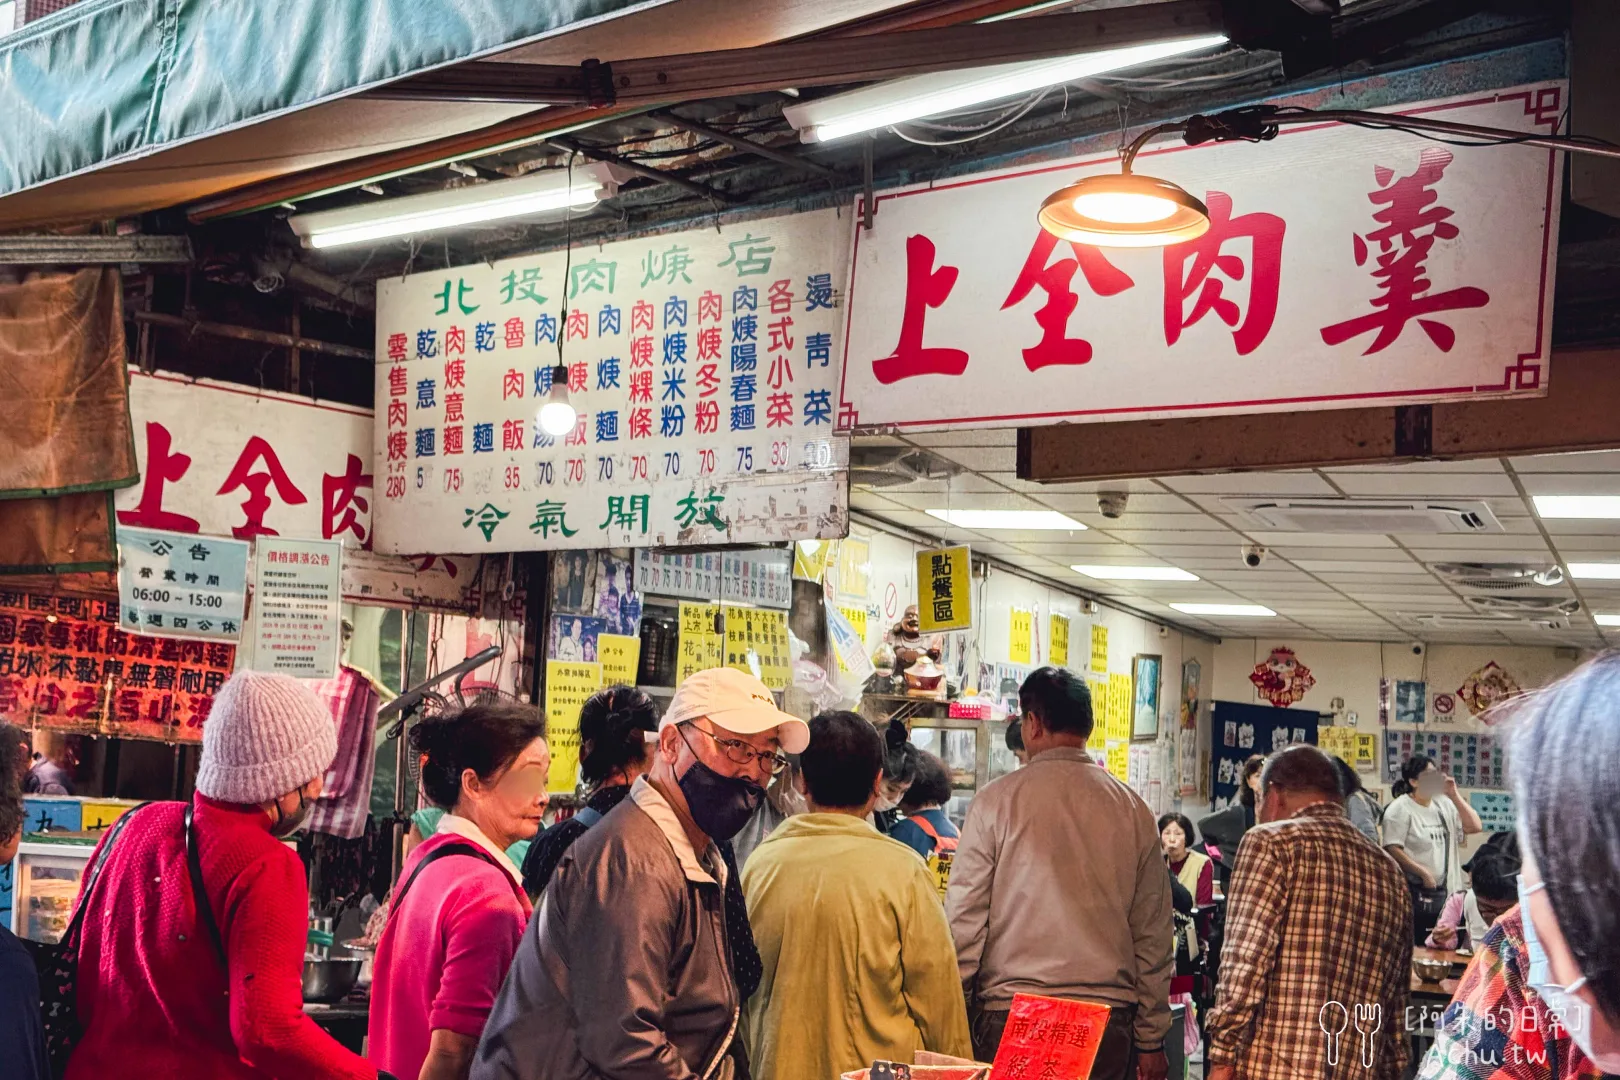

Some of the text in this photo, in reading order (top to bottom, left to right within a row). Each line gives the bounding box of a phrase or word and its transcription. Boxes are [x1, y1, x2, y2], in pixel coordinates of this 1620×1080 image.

[434, 233, 776, 316] 北投肉焿店
[872, 147, 1490, 385] 上全肉羹
[386, 333, 408, 460] 零售肉焿
[416, 327, 436, 459] 乾意麵
[443, 326, 466, 492] 肉焿意麵 75
[473, 321, 496, 454] 乾麵
[502, 317, 524, 488] 魯肉飯 35
[596, 304, 622, 480] 肉焿麵 70
[628, 300, 654, 479] 肉焿粿條 70
[660, 296, 688, 476] 肉焿米粉 70
[694, 290, 722, 474] 肉焿冬粉 70
[730, 285, 758, 471] 肉焿陽春麵 75
[766, 279, 794, 466] 各式小菜 30
[386, 476, 406, 498] 280
[462, 490, 728, 542] 冷氣開放
[539, 462, 553, 485] 70
[568, 460, 584, 482] 70
[132, 587, 170, 603] 06:00
[188, 593, 222, 608] 15:00
[139, 567, 220, 586] 營業時間
[150, 540, 211, 562] 公告
[932, 554, 953, 622] 點餐區
[128, 610, 237, 634] 每週四公休
[1010, 1017, 1090, 1049] 南投精選
